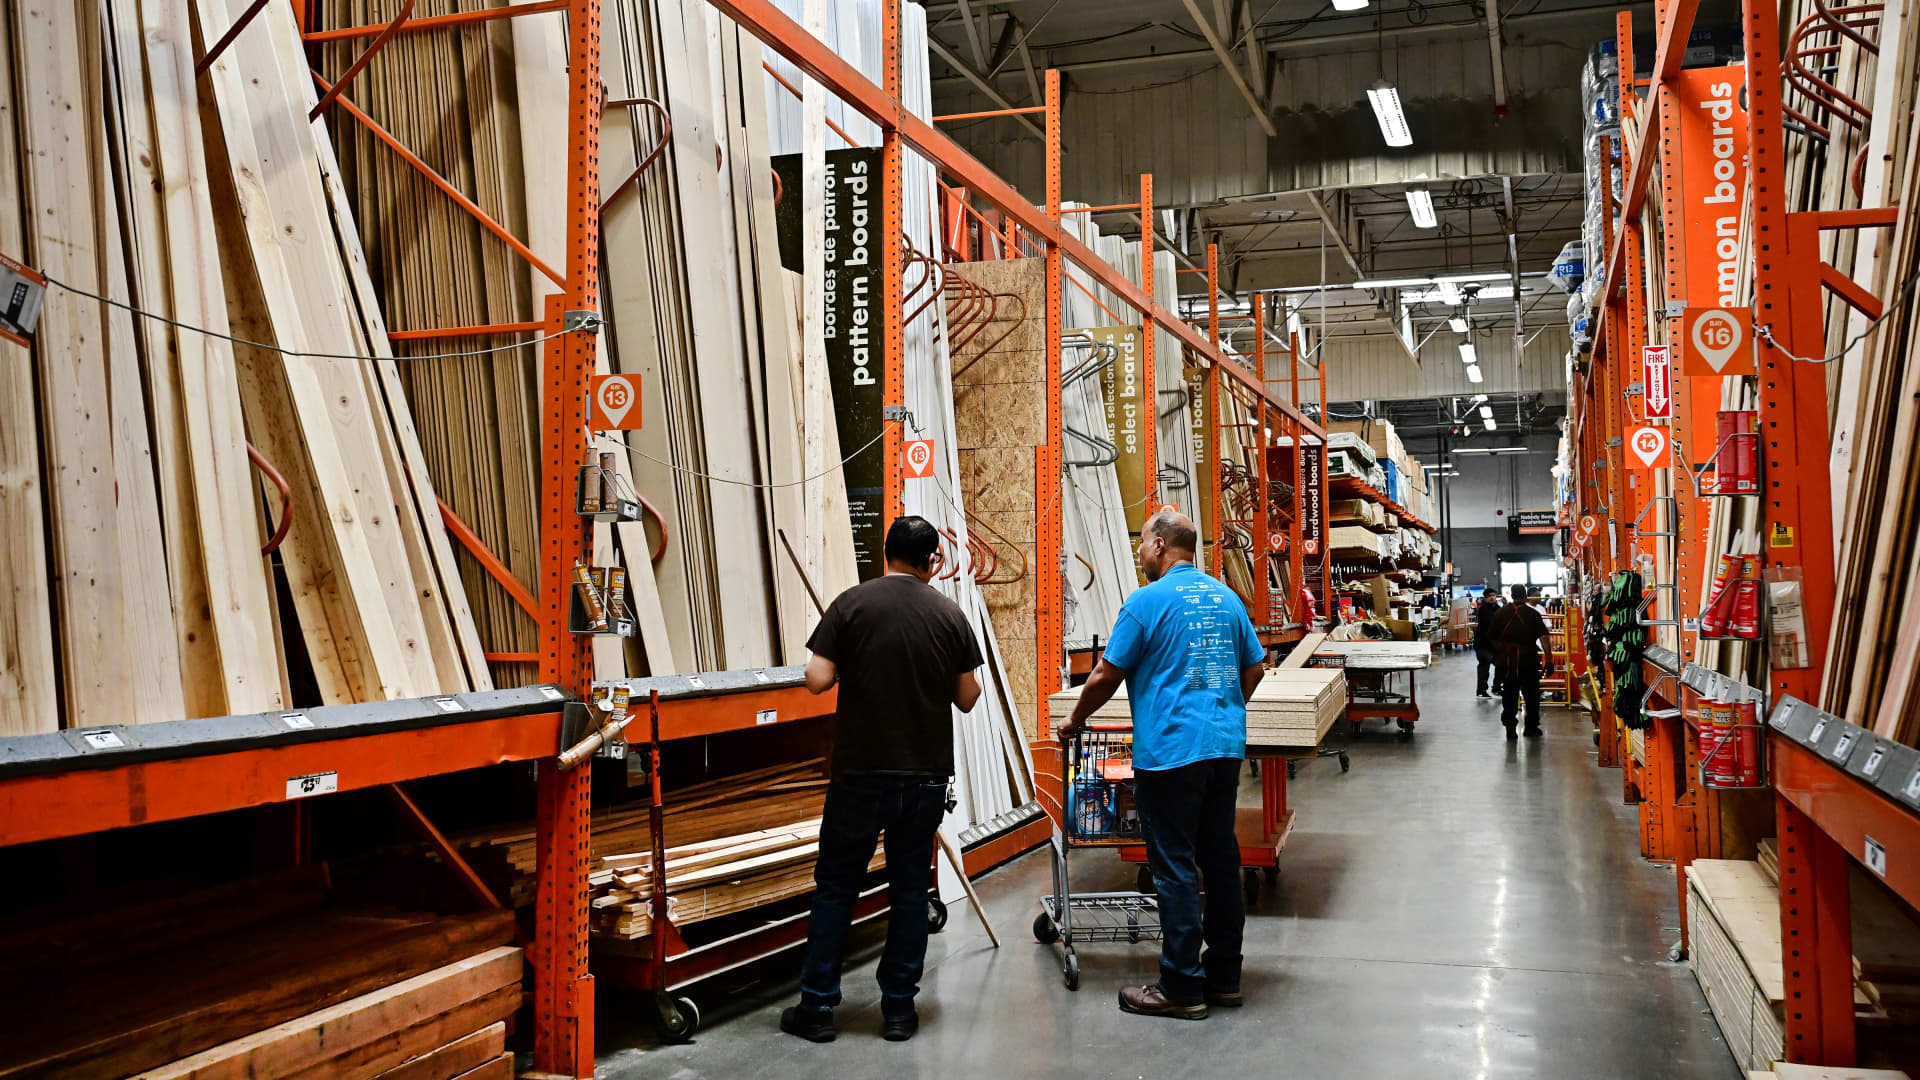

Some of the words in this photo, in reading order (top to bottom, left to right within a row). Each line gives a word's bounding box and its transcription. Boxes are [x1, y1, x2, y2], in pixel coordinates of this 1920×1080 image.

[1700, 82, 1735, 204] boards
[844, 160, 868, 267] boards
[1559, 265, 1574, 273] R13
[824, 268, 836, 338] bordes
[849, 276, 876, 386] pattern
[1704, 328, 1730, 345] 16
[1119, 332, 1135, 398] boards
[1648, 354, 1665, 363] FIRE
[606, 391, 626, 405] 13
[1188, 374, 1203, 428] boards
[1120, 402, 1136, 454] select
[1640, 439, 1656, 449] 14
[913, 451, 925, 461] 13
[1308, 449, 1318, 486] boards
